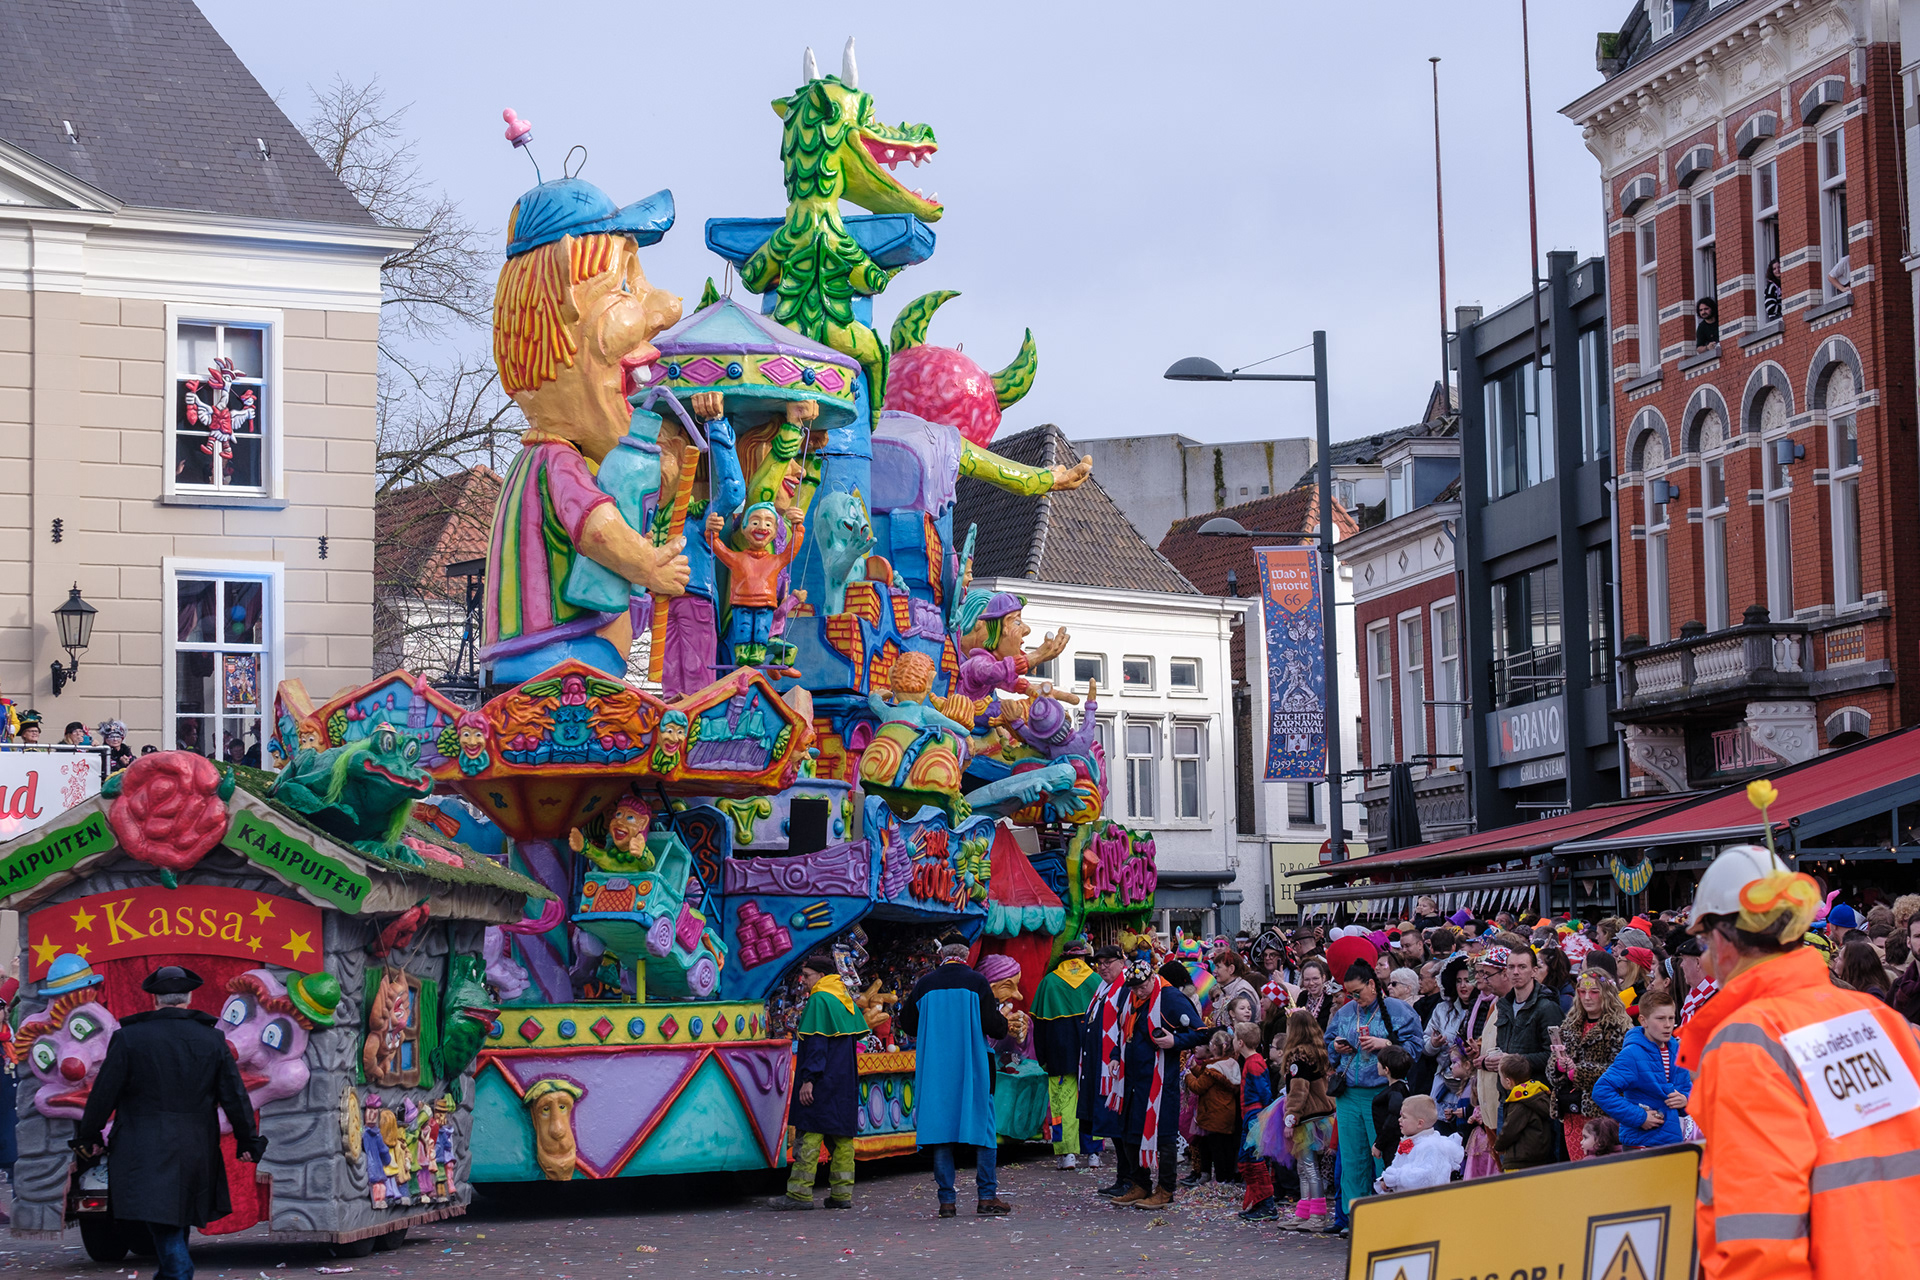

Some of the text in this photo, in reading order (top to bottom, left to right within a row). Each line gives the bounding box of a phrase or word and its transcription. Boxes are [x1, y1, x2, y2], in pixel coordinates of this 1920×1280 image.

[1284, 593, 1302, 606] 66
[1273, 713, 1324, 721] STICHTING
[1273, 720, 1324, 728] CARNAVAL
[1273, 727, 1324, 735] ROOSENDAAL
[1511, 705, 1560, 753] BRAVO
[1520, 759, 1564, 781] GRILL & STEAK
[237, 823, 363, 901] KAAIPUITEN
[911, 862, 956, 903] GOOIE
[100, 898, 244, 946] Kassa
[1826, 1033, 1854, 1054] niets
[1847, 1027, 1865, 1047] in
[1862, 1023, 1878, 1041] de
[1824, 1048, 1892, 1101] GATEN
